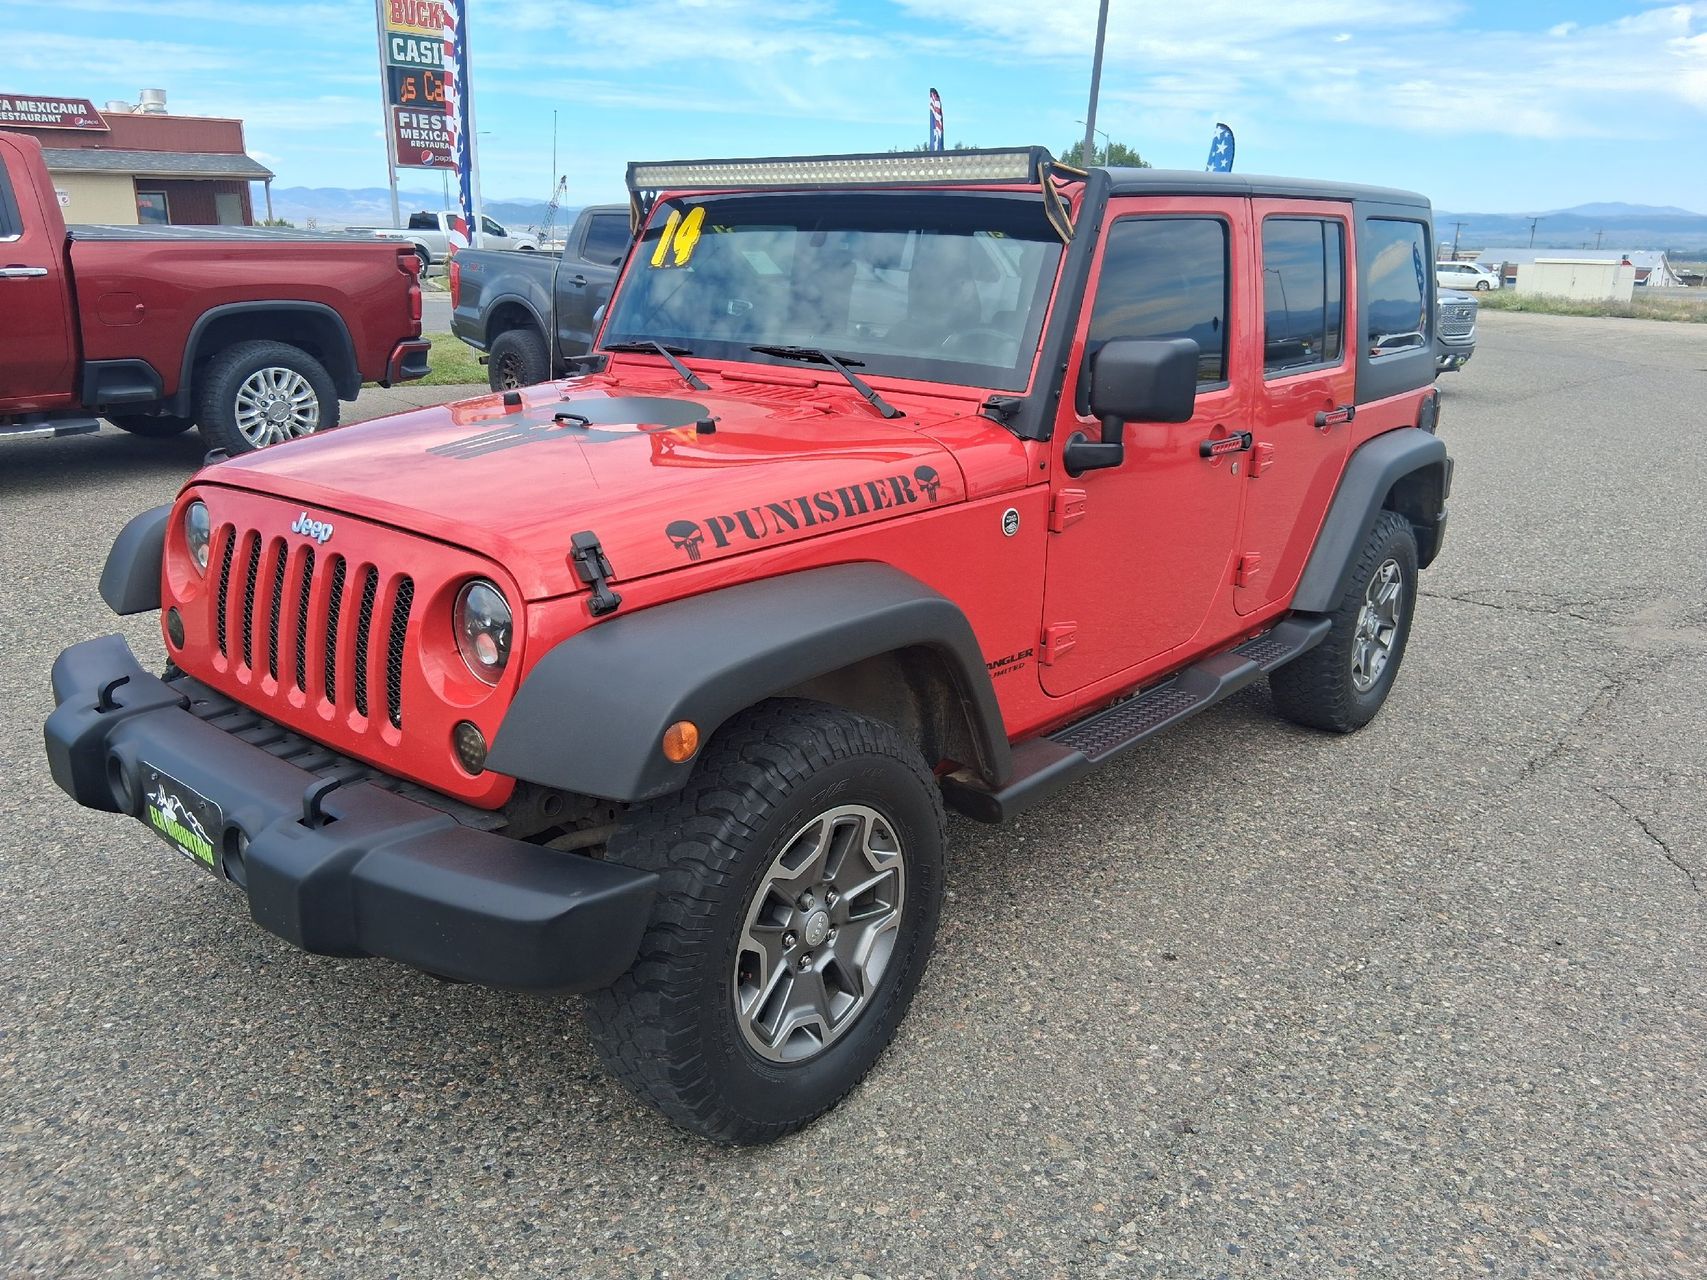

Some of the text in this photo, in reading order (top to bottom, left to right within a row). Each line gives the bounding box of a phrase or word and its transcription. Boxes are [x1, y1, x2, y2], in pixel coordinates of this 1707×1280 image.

[0, 99, 87, 114] A MEXICANA
[0, 111, 61, 123] ESTAURANT
[651, 206, 706, 267] 14
[291, 511, 334, 545] Jeep
[703, 475, 918, 549] PUNISHER
